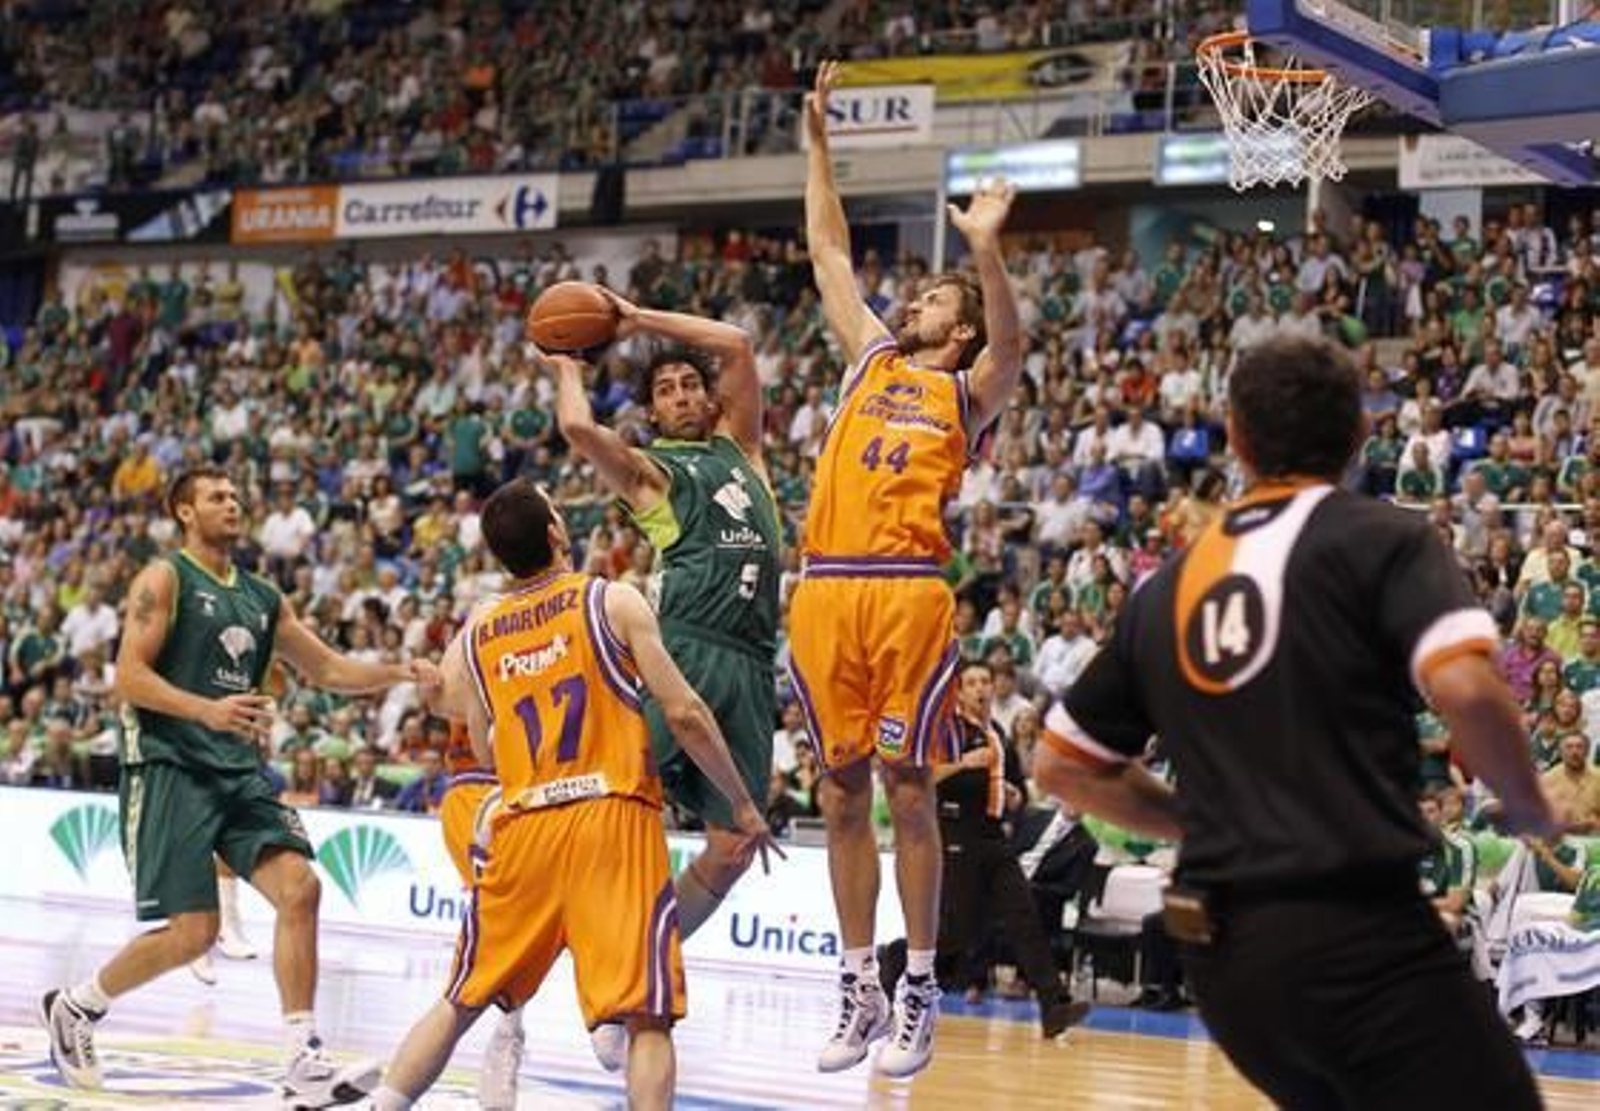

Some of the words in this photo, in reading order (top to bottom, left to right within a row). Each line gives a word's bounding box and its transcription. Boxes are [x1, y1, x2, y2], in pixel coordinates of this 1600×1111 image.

[826, 97, 912, 122] SUR
[344, 195, 483, 225] Carrefour
[861, 437, 910, 475] 44
[1203, 591, 1250, 664] 14
[513, 673, 587, 776] 17
